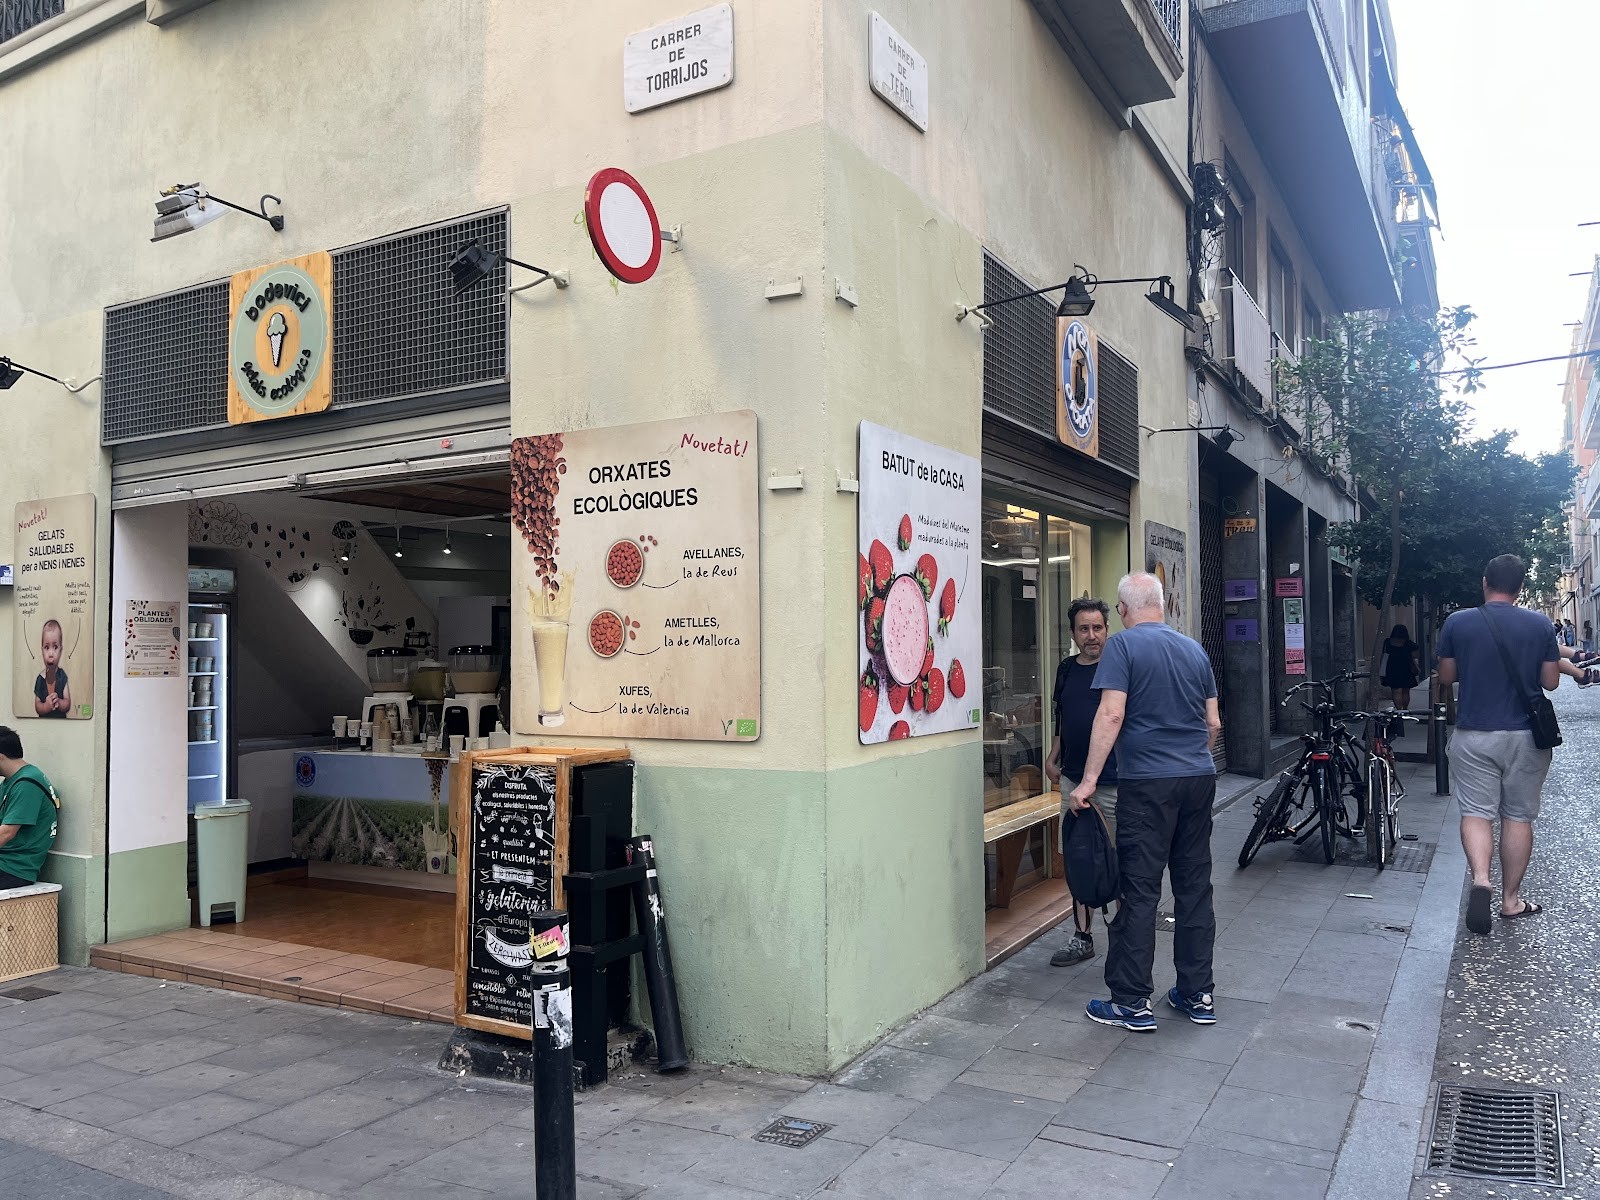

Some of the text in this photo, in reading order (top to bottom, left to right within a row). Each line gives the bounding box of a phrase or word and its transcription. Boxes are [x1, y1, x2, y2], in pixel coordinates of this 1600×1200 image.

[651, 24, 702, 50] CARRER
[669, 47, 685, 63] DE
[888, 36, 915, 70] CARRER
[646, 59, 708, 93] TORRIJOS
[897, 62, 907, 79] DE
[891, 73, 914, 108] TEROL
[245, 282, 311, 322] bodevici
[681, 433, 748, 457] Novetat!
[588, 459, 671, 484] ORXATES
[882, 450, 965, 491] BATUT de la CASA
[573, 487, 698, 515] ECOLÒGIQUES
[18, 507, 48, 533] Novetat!
[38, 529, 65, 541] GELATS
[29, 543, 75, 557] SALUDABLES
[682, 547, 745, 560] AVELLANES,
[21, 563, 32, 575] per
[33, 563, 38, 571] a
[39, 559, 57, 570] NENS
[61, 557, 85, 569] NENES
[683, 564, 738, 578] la de Reus
[664, 617, 720, 630] AMETLLES,
[664, 635, 741, 647] la de Mallorca
[619, 685, 653, 698] XUFES,
[619, 703, 690, 716] la de València
[504, 781, 528, 791] DISFRUTA
[491, 850, 536, 866] ET PRESENTEM
